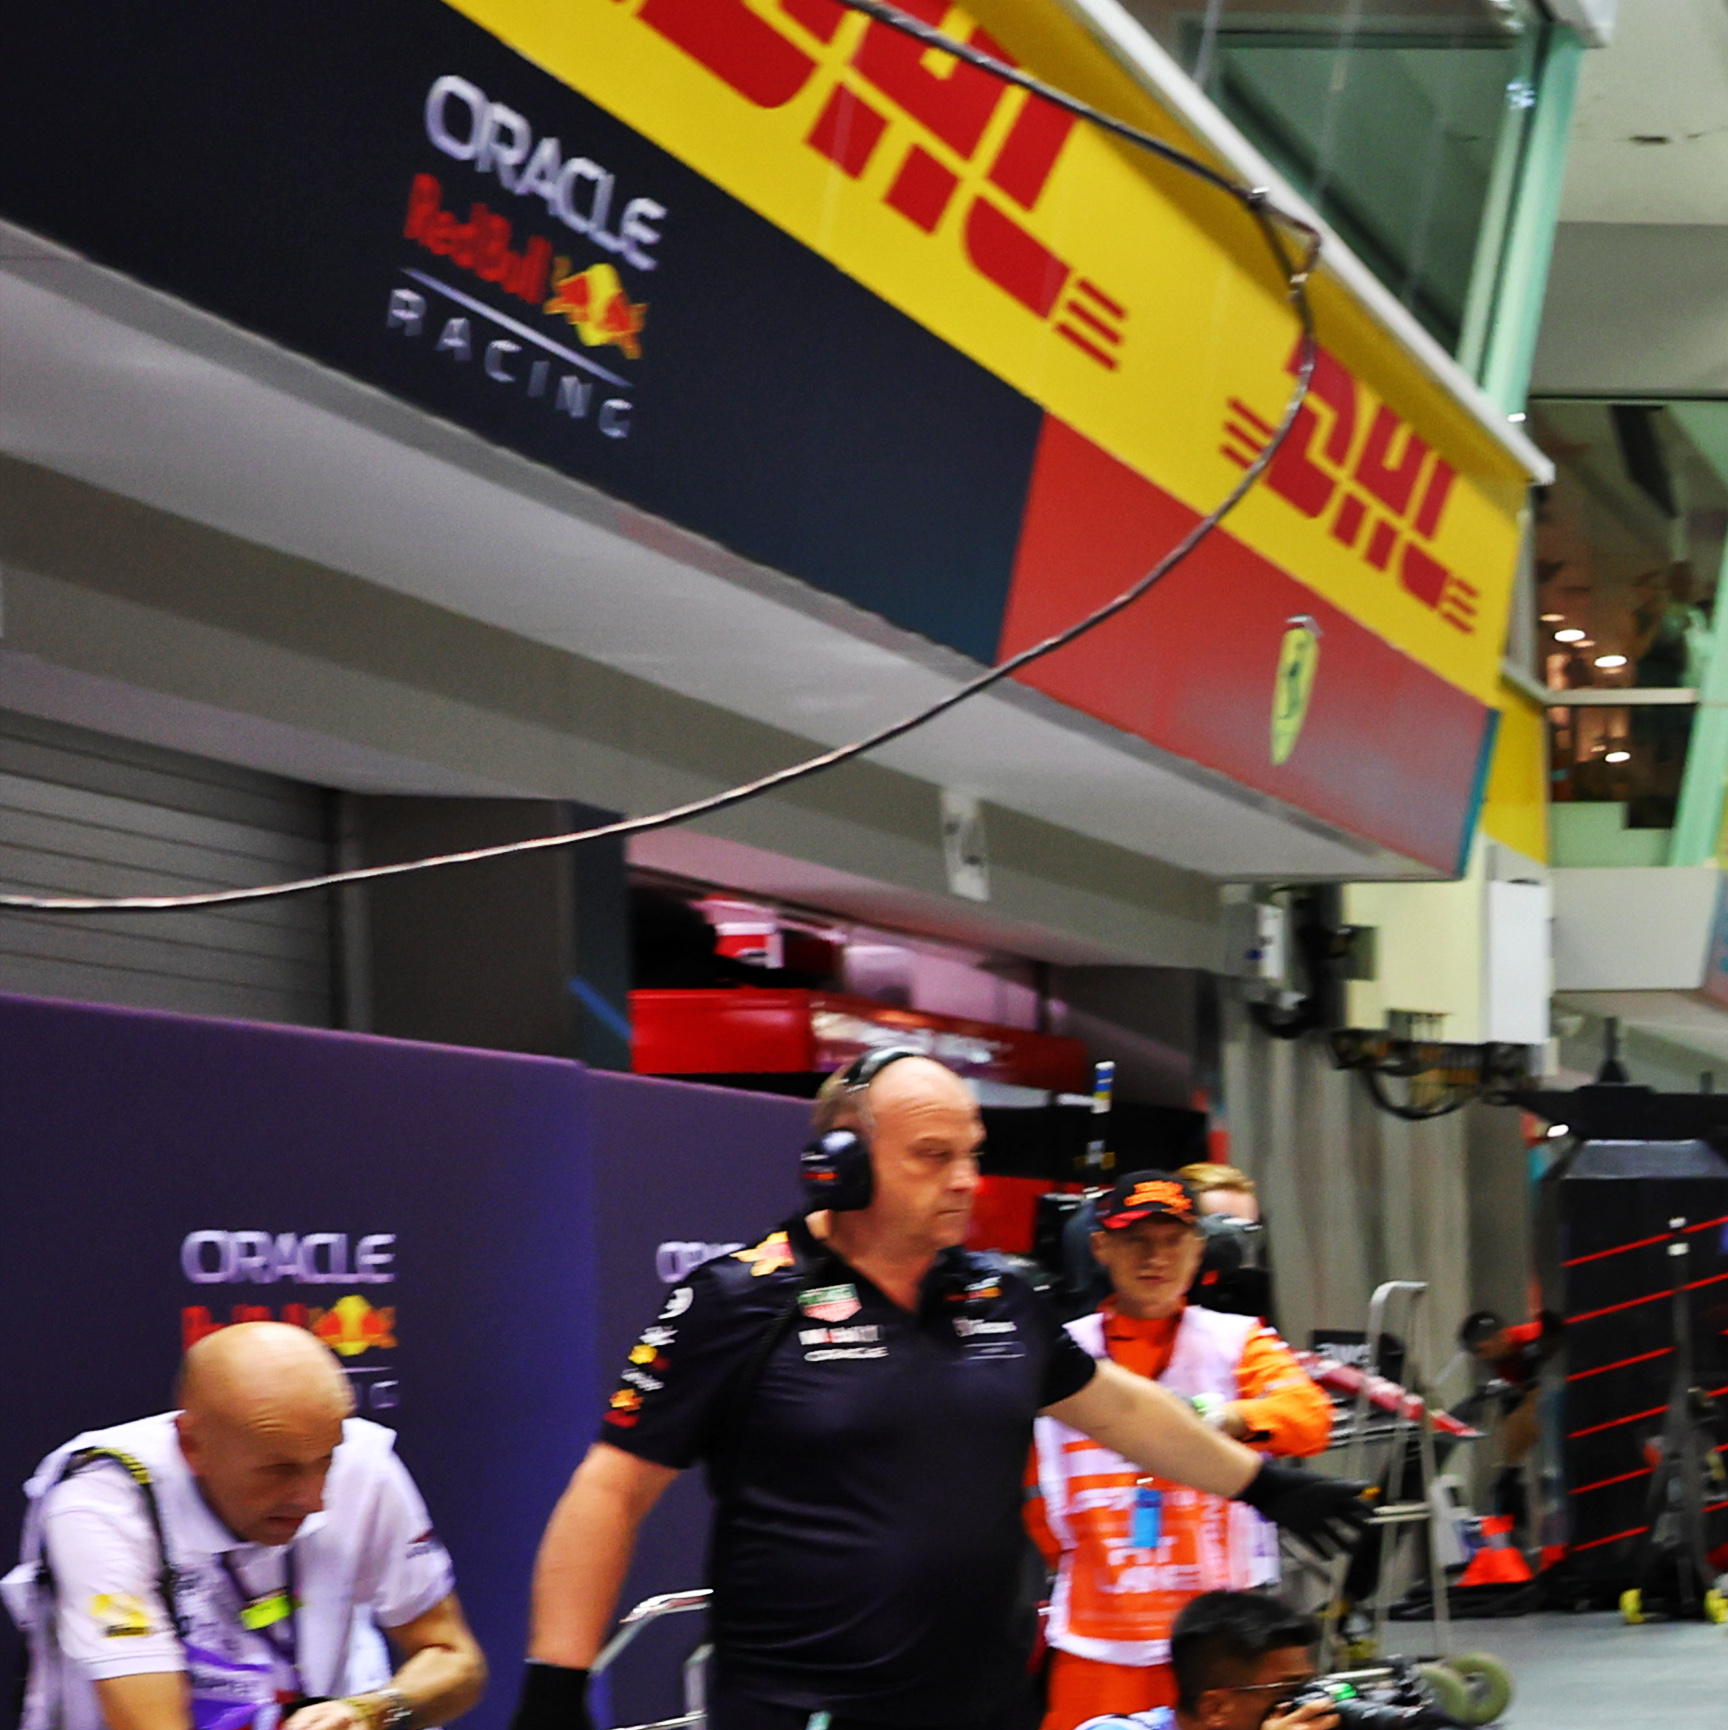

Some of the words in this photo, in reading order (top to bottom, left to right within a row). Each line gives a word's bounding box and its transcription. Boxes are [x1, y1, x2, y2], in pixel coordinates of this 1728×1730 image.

[424, 75, 669, 271] ORACLE
[386, 288, 634, 438] RACING
[1263, 336, 1458, 612] DHL
[180, 1229, 398, 1284] ORACLE
